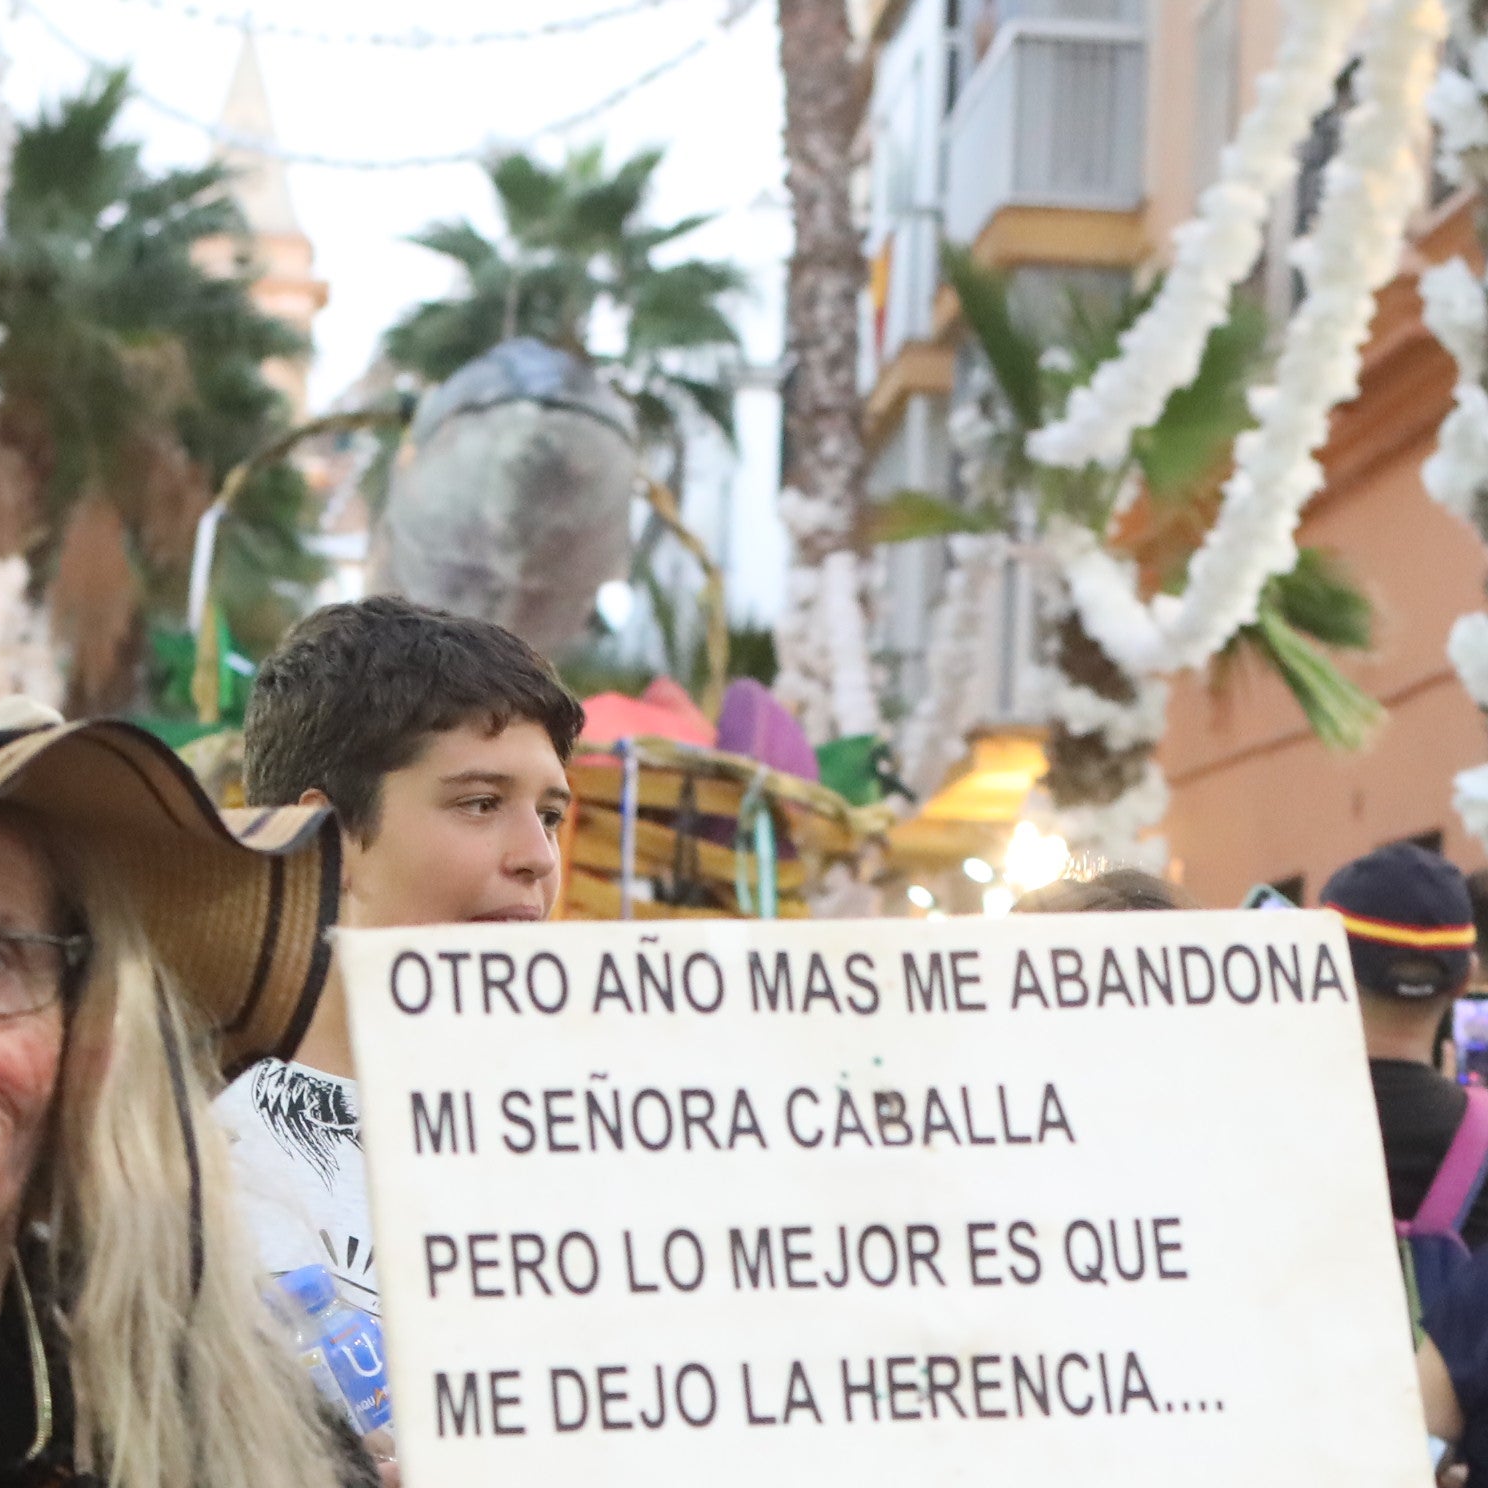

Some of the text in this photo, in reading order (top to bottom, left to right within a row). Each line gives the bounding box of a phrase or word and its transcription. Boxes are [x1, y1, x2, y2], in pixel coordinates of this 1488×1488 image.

[391, 937, 1349, 1015] OTRO AÑO MAS ME ABANDONA
[411, 1073, 1074, 1153] MI SEÑORA CABALLA
[425, 1218, 1187, 1297] PERO LO MEJOR ES QUE
[435, 1371, 525, 1436] ME
[551, 1363, 716, 1432] DEJO
[743, 1361, 822, 1424] LA
